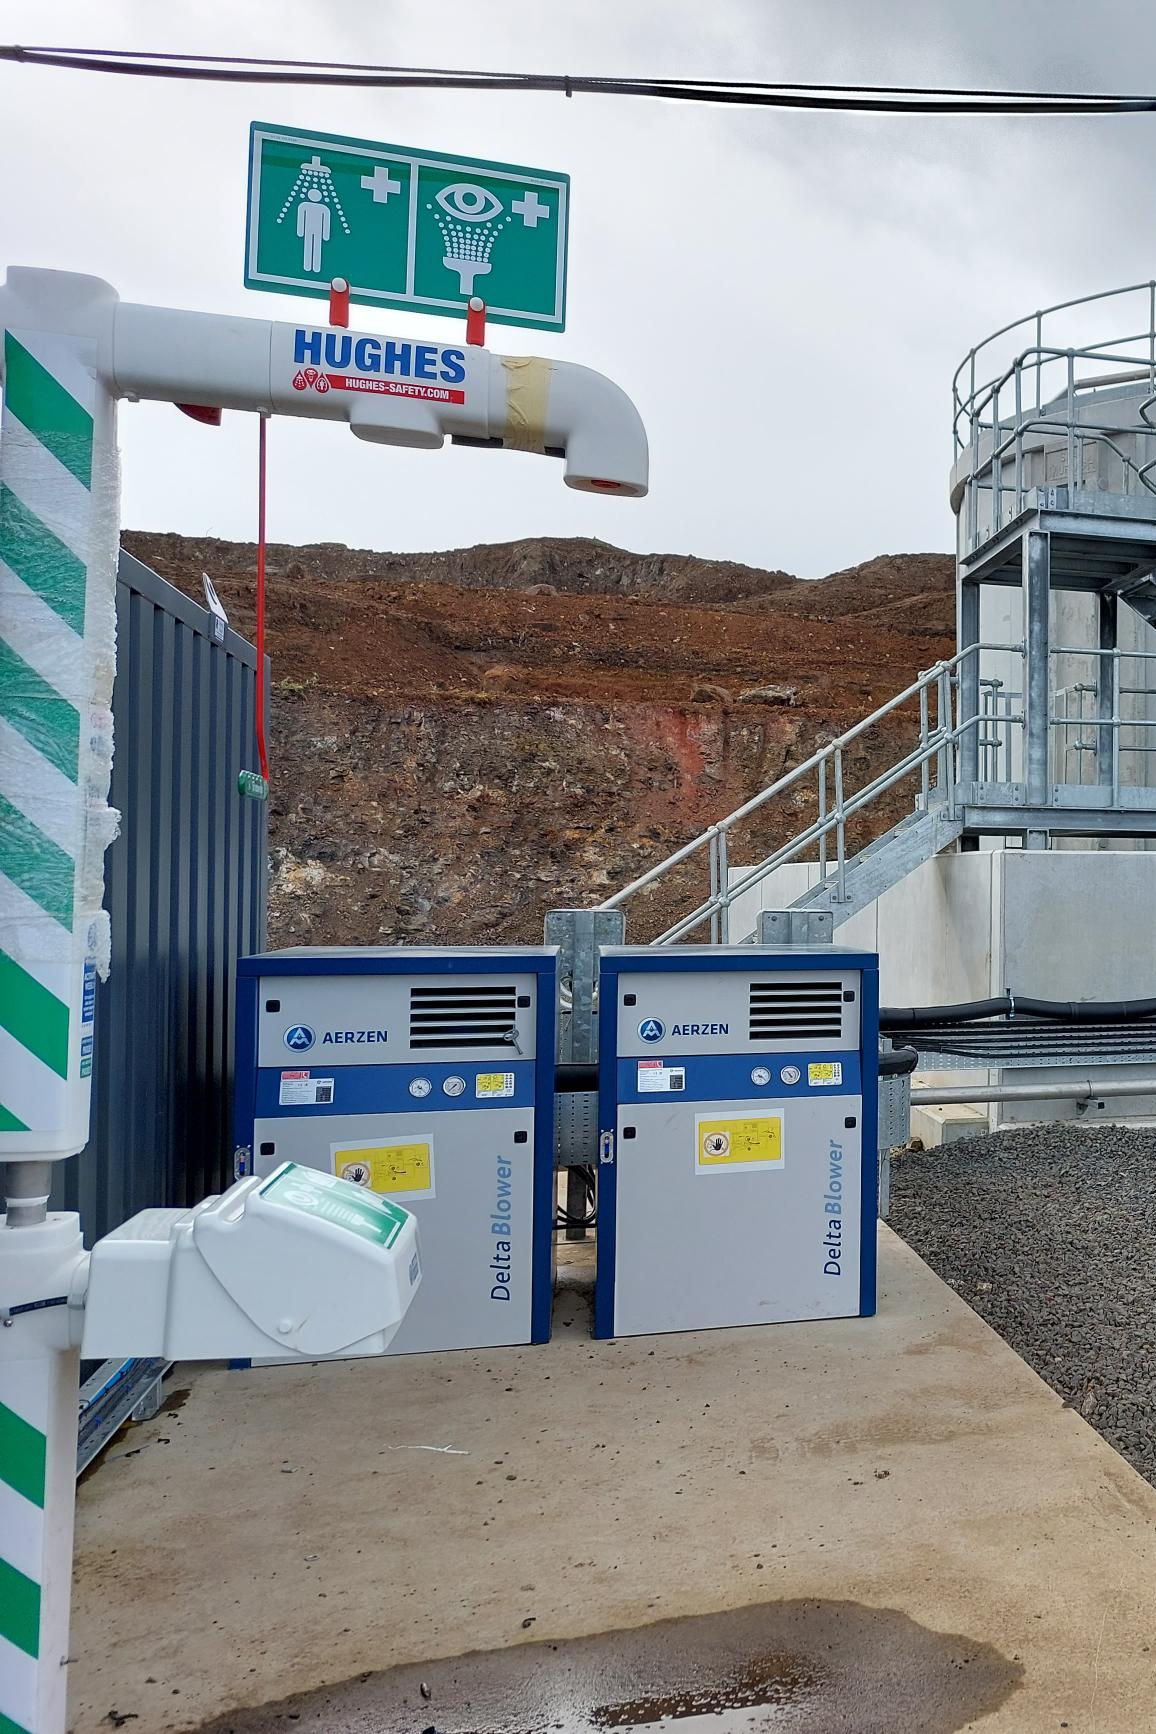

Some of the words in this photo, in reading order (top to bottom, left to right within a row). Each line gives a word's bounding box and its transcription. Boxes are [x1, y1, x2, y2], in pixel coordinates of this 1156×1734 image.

[294, 329, 466, 384] HUGHES
[345, 377, 449, 400] HUGHES-SAFETY.COM
[322, 1030, 388, 1044] AERZEN
[672, 1023, 729, 1036] AERZEN
